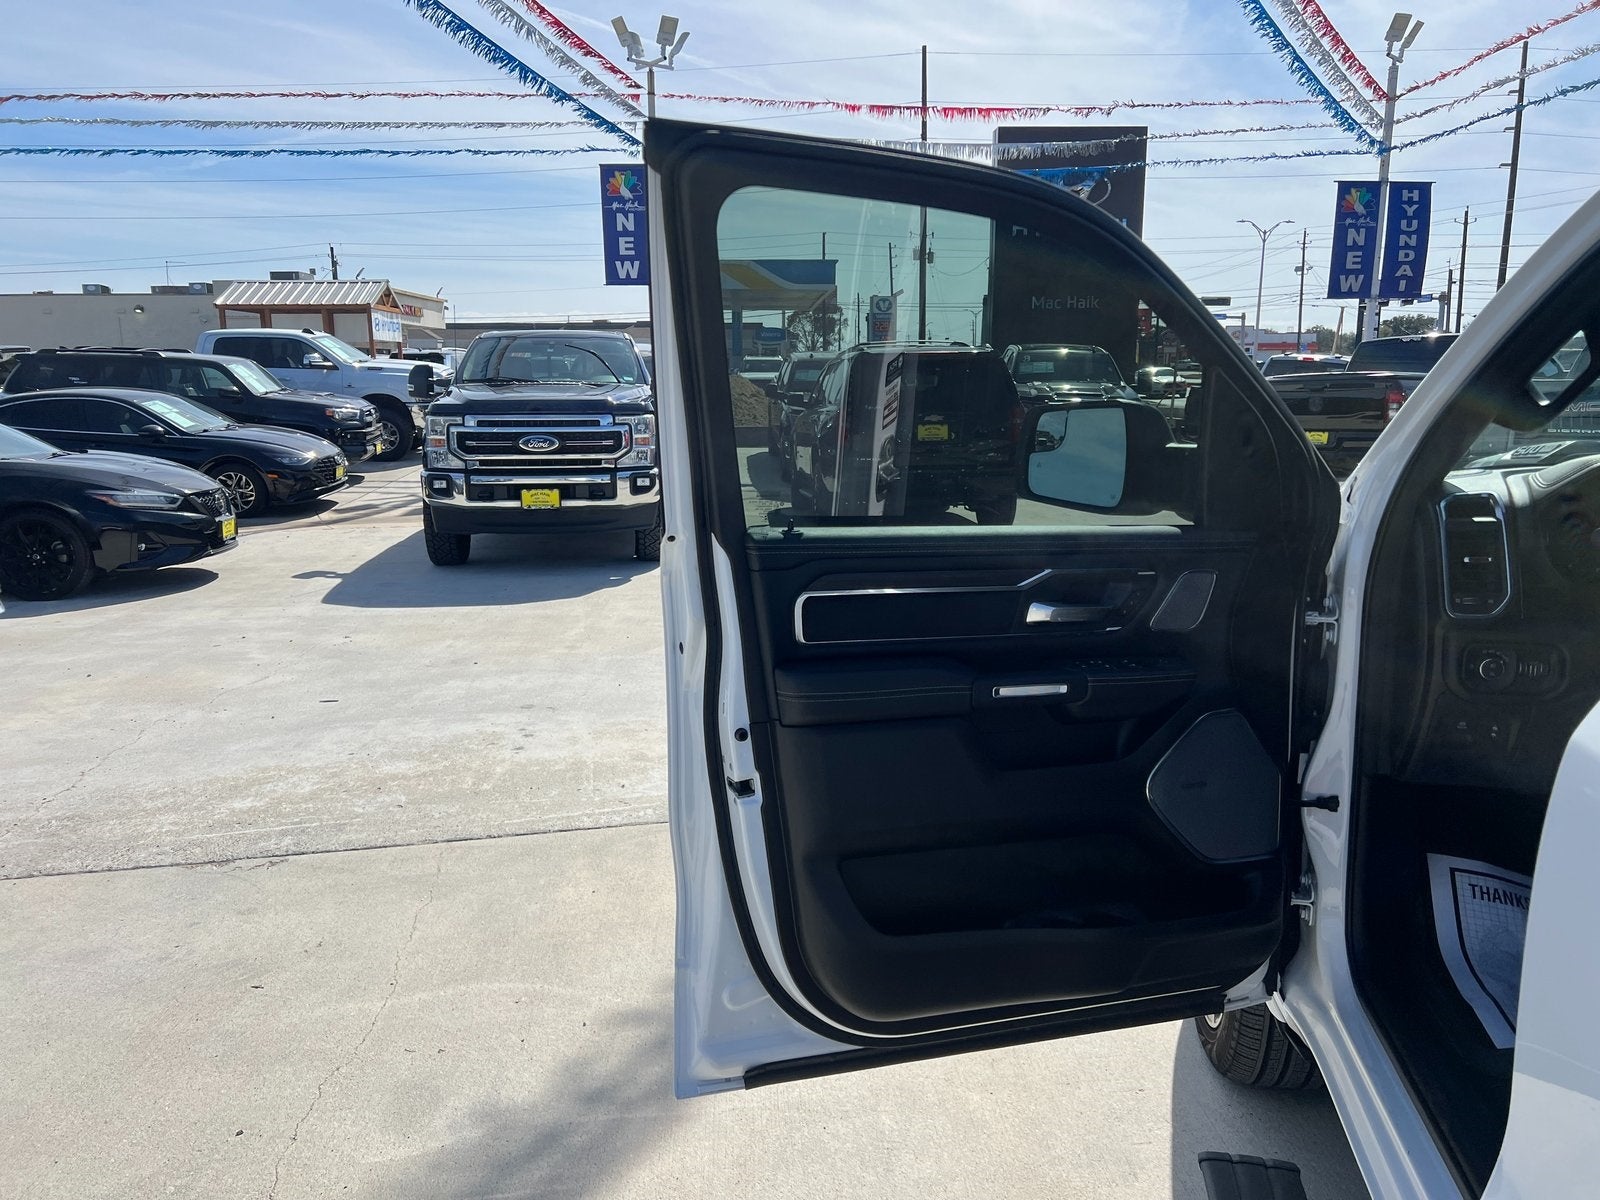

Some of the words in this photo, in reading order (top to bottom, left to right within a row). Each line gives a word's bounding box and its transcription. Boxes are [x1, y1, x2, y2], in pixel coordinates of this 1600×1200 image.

[615, 213, 640, 279] NEW
[1340, 228, 1366, 292] NEW
[1394, 189, 1420, 292] HYUNDAI
[1032, 296, 1062, 310] Mac
[1067, 296, 1100, 310] Haik
[1565, 402, 1600, 412] MC
[528, 438, 550, 448] Ford
